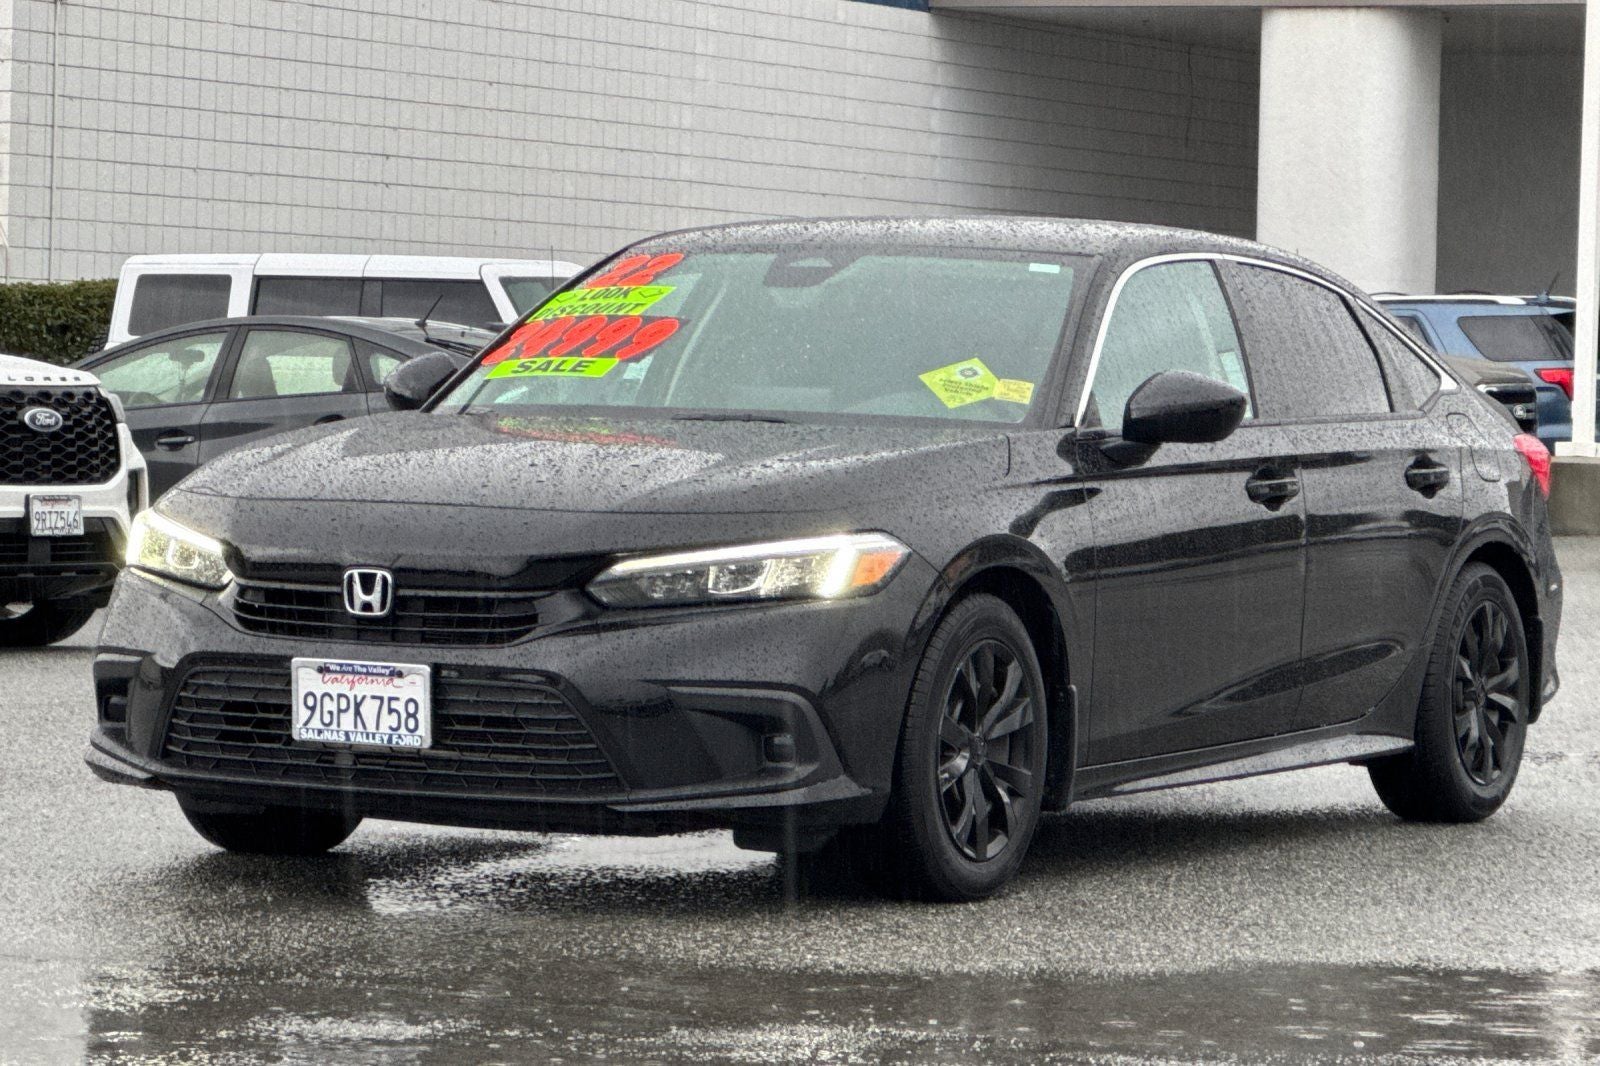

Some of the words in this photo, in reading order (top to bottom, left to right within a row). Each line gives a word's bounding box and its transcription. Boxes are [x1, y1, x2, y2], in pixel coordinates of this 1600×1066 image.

[578, 287, 638, 301] LOOK
[532, 302, 648, 321] DISCOUNT
[511, 360, 597, 374] SALE
[36, 412, 56, 426] Ford
[353, 664, 367, 673] The
[322, 673, 403, 691] California
[303, 690, 420, 733] 9GPK758
[349, 730, 389, 745] VALLEY
